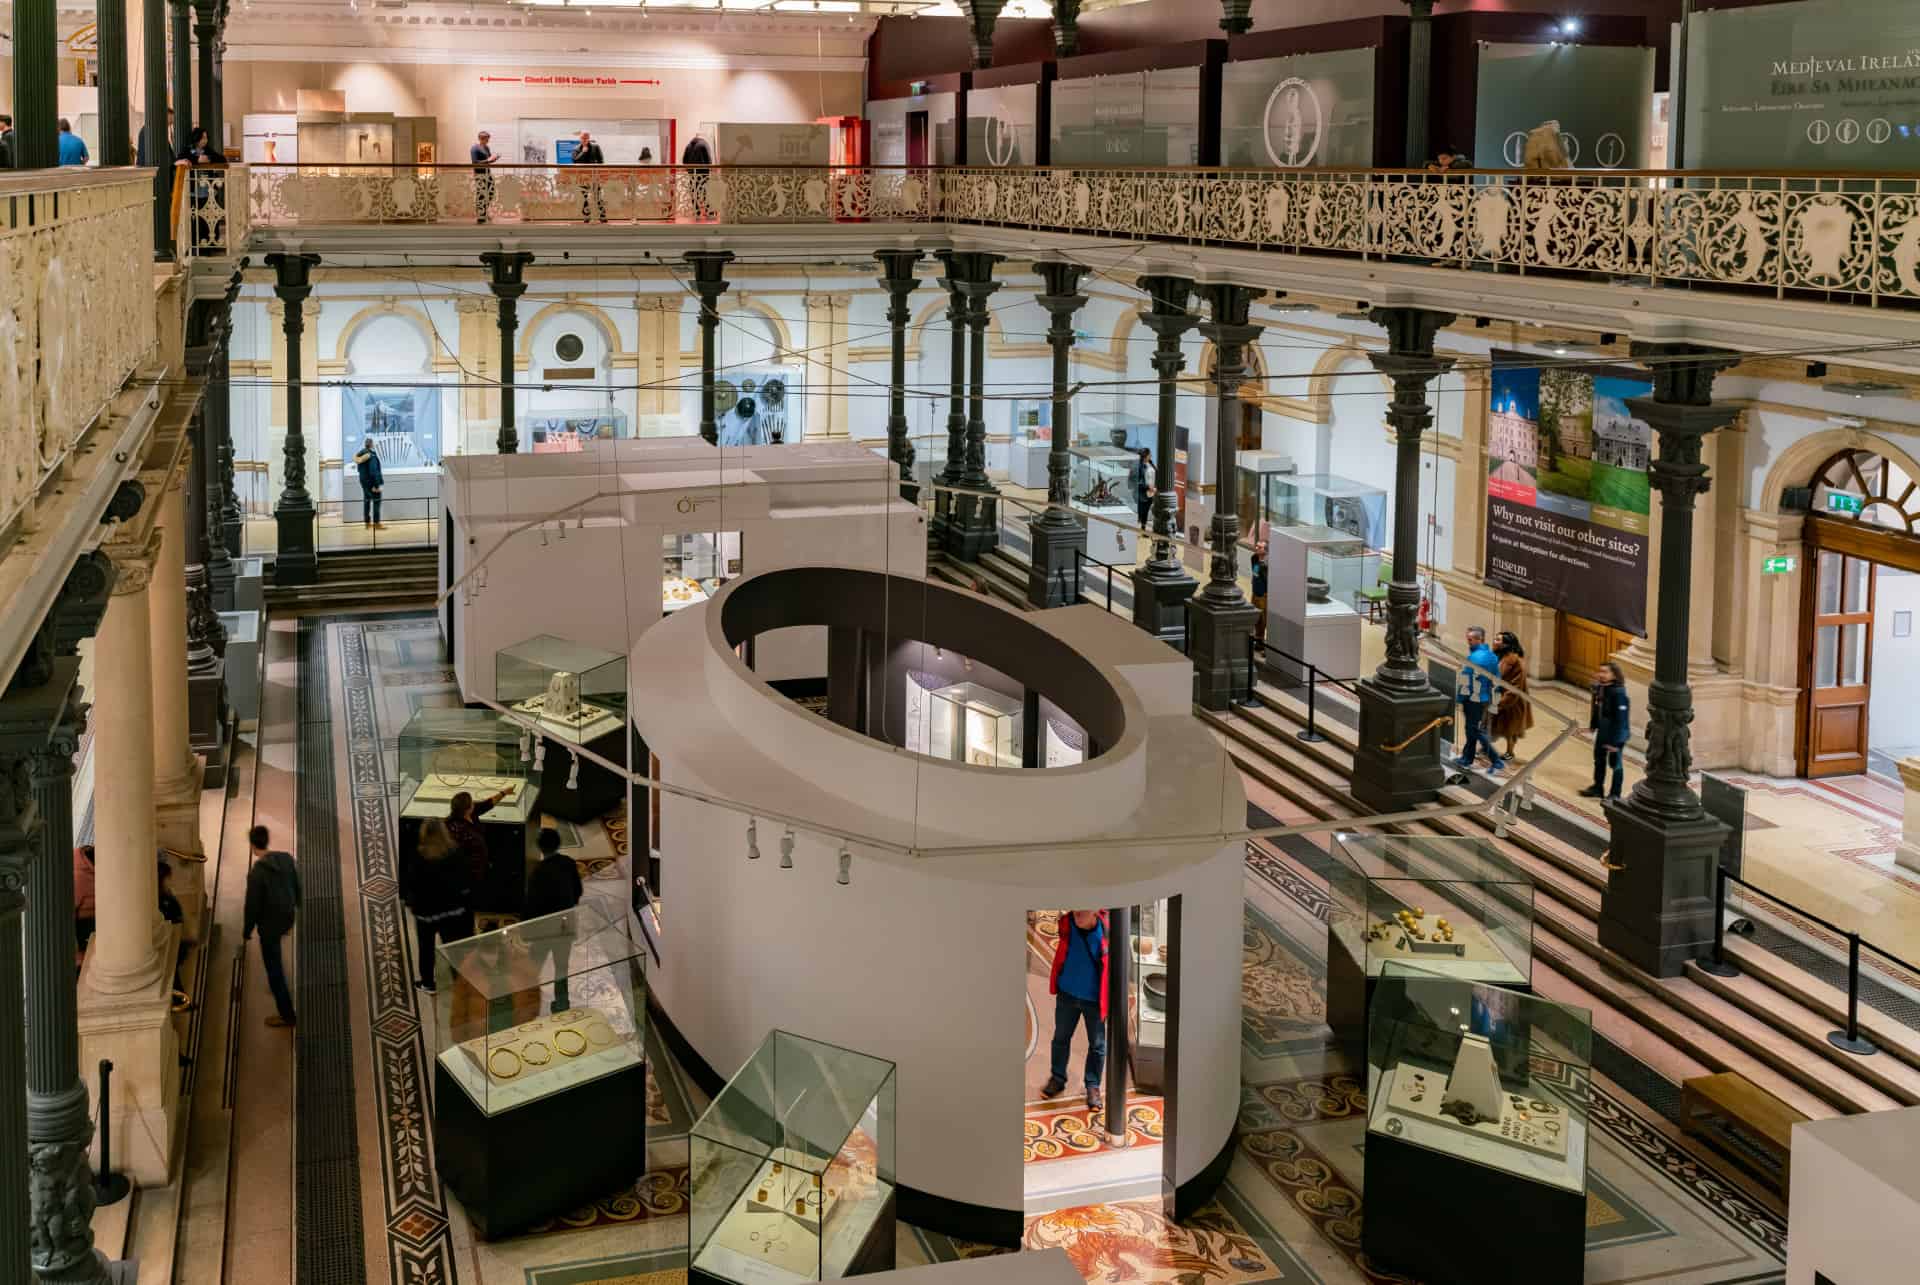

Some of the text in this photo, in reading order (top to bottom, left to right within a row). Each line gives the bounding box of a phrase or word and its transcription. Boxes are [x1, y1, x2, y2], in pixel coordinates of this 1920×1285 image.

[1492, 503, 1640, 556] Why not visit our other sites?
